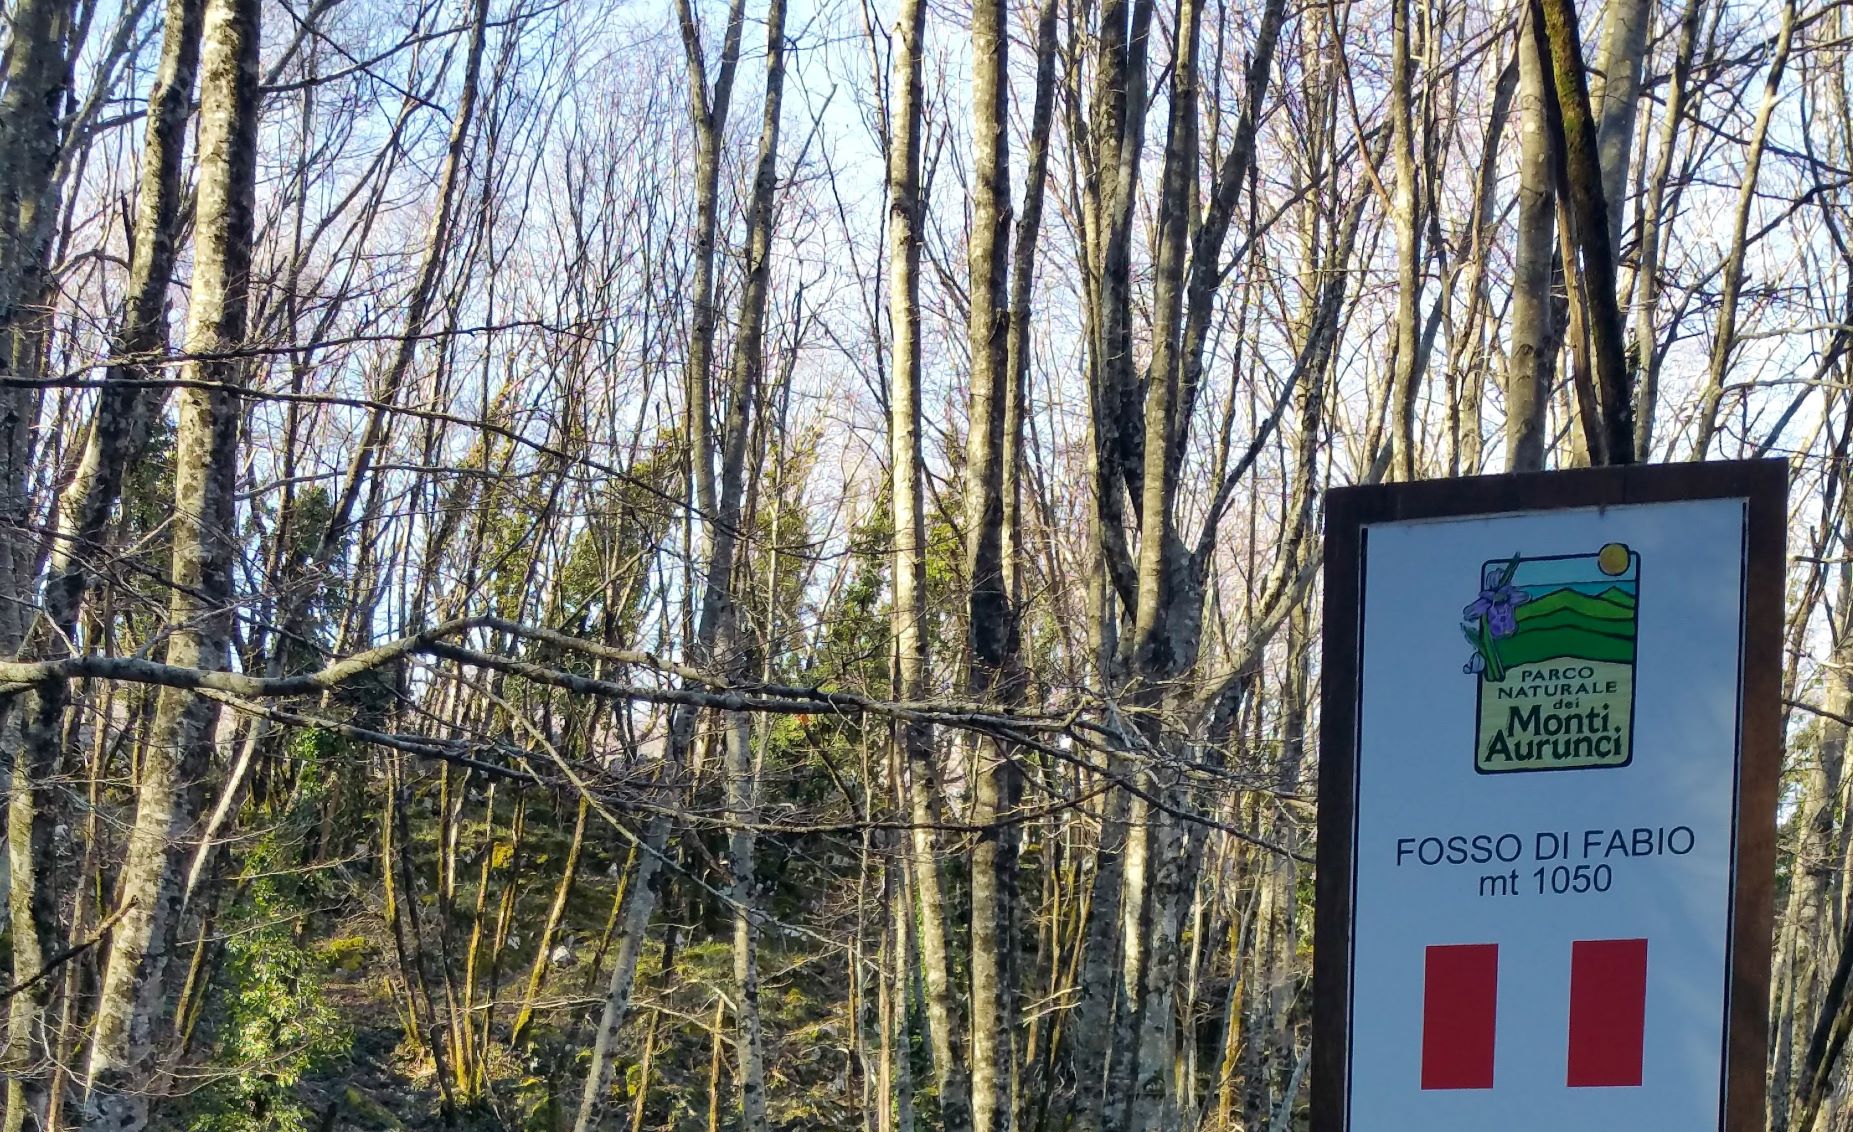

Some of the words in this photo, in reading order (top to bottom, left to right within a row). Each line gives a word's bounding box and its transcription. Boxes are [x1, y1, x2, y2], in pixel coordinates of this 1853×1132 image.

[1497, 682, 1617, 699] NATURALE
[1521, 667, 1594, 682] PARCO
[1507, 703, 1610, 737] Monti
[1552, 698, 1580, 710] dei
[1484, 726, 1622, 762] Aurunci
[1396, 833, 1522, 866] FOSSO
[1535, 832, 1569, 860] DI
[1583, 826, 1695, 858] FABIO
[1479, 869, 1519, 896] mt
[1532, 864, 1613, 894] 1050
